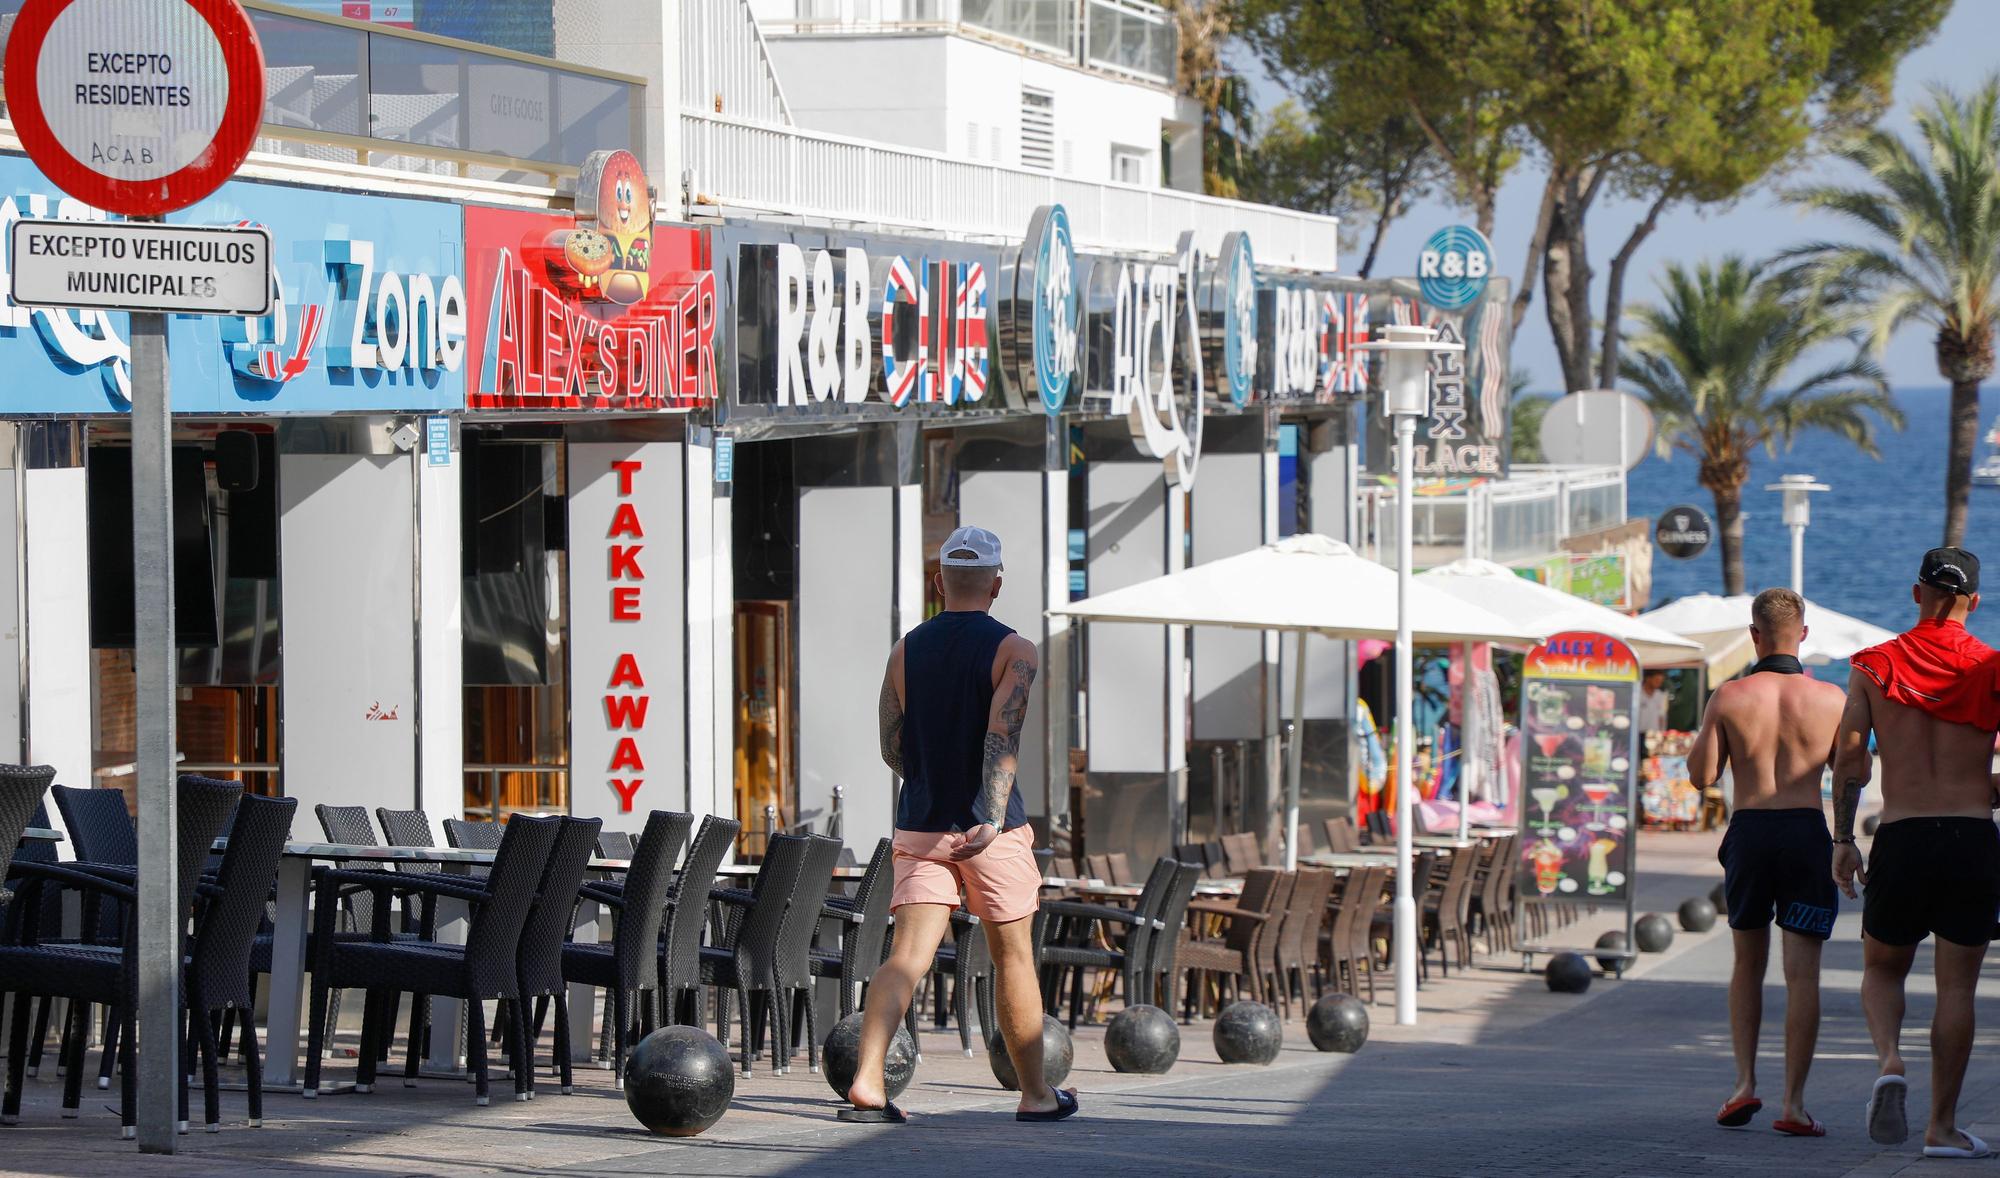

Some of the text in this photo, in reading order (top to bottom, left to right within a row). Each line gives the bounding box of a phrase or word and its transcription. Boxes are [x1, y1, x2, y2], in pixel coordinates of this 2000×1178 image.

[87, 52, 172, 75] EXCEPTO
[75, 83, 191, 107] RESIDENTES
[29, 234, 256, 265] EXCEPTO VEHICULOS
[1420, 249, 1488, 280] R&B
[67, 270, 218, 299] MUNICIPALES
[350, 240, 467, 373] Zone
[478, 246, 619, 398] ALEX'S
[627, 270, 719, 399] DINER
[777, 242, 872, 407] R&B
[882, 255, 989, 408] CLUB
[603, 460, 650, 814] TAKE AWAY
